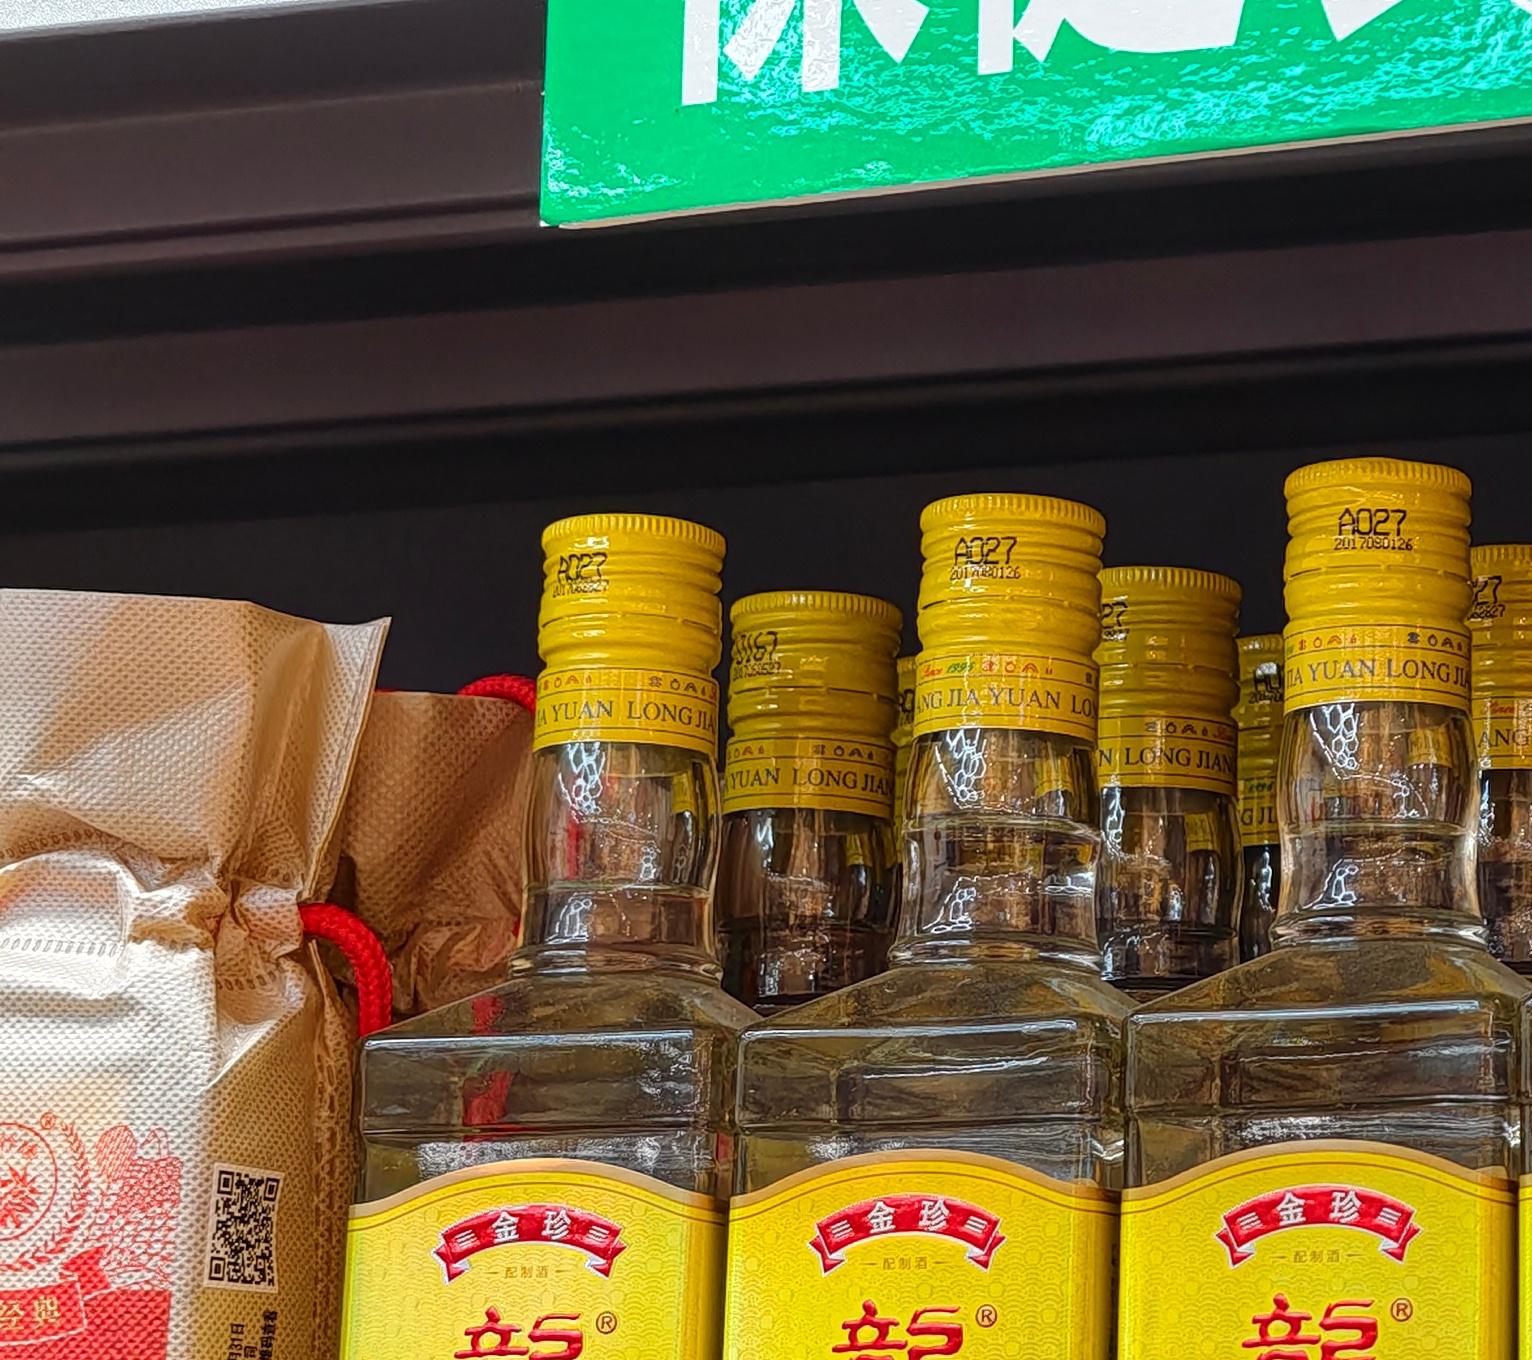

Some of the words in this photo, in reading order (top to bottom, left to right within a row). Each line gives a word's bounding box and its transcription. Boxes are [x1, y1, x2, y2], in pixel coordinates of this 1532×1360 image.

[1337, 507, 1408, 538] A027
[953, 535, 1018, 565] A027
[1308, 658, 1376, 682] YUAN
[1386, 658, 1451, 684] LONG
[986, 688, 1061, 711] YUAN
[627, 700, 693, 729] LONG
[1124, 747, 1193, 770] LONG
[792, 768, 858, 790] LONG
